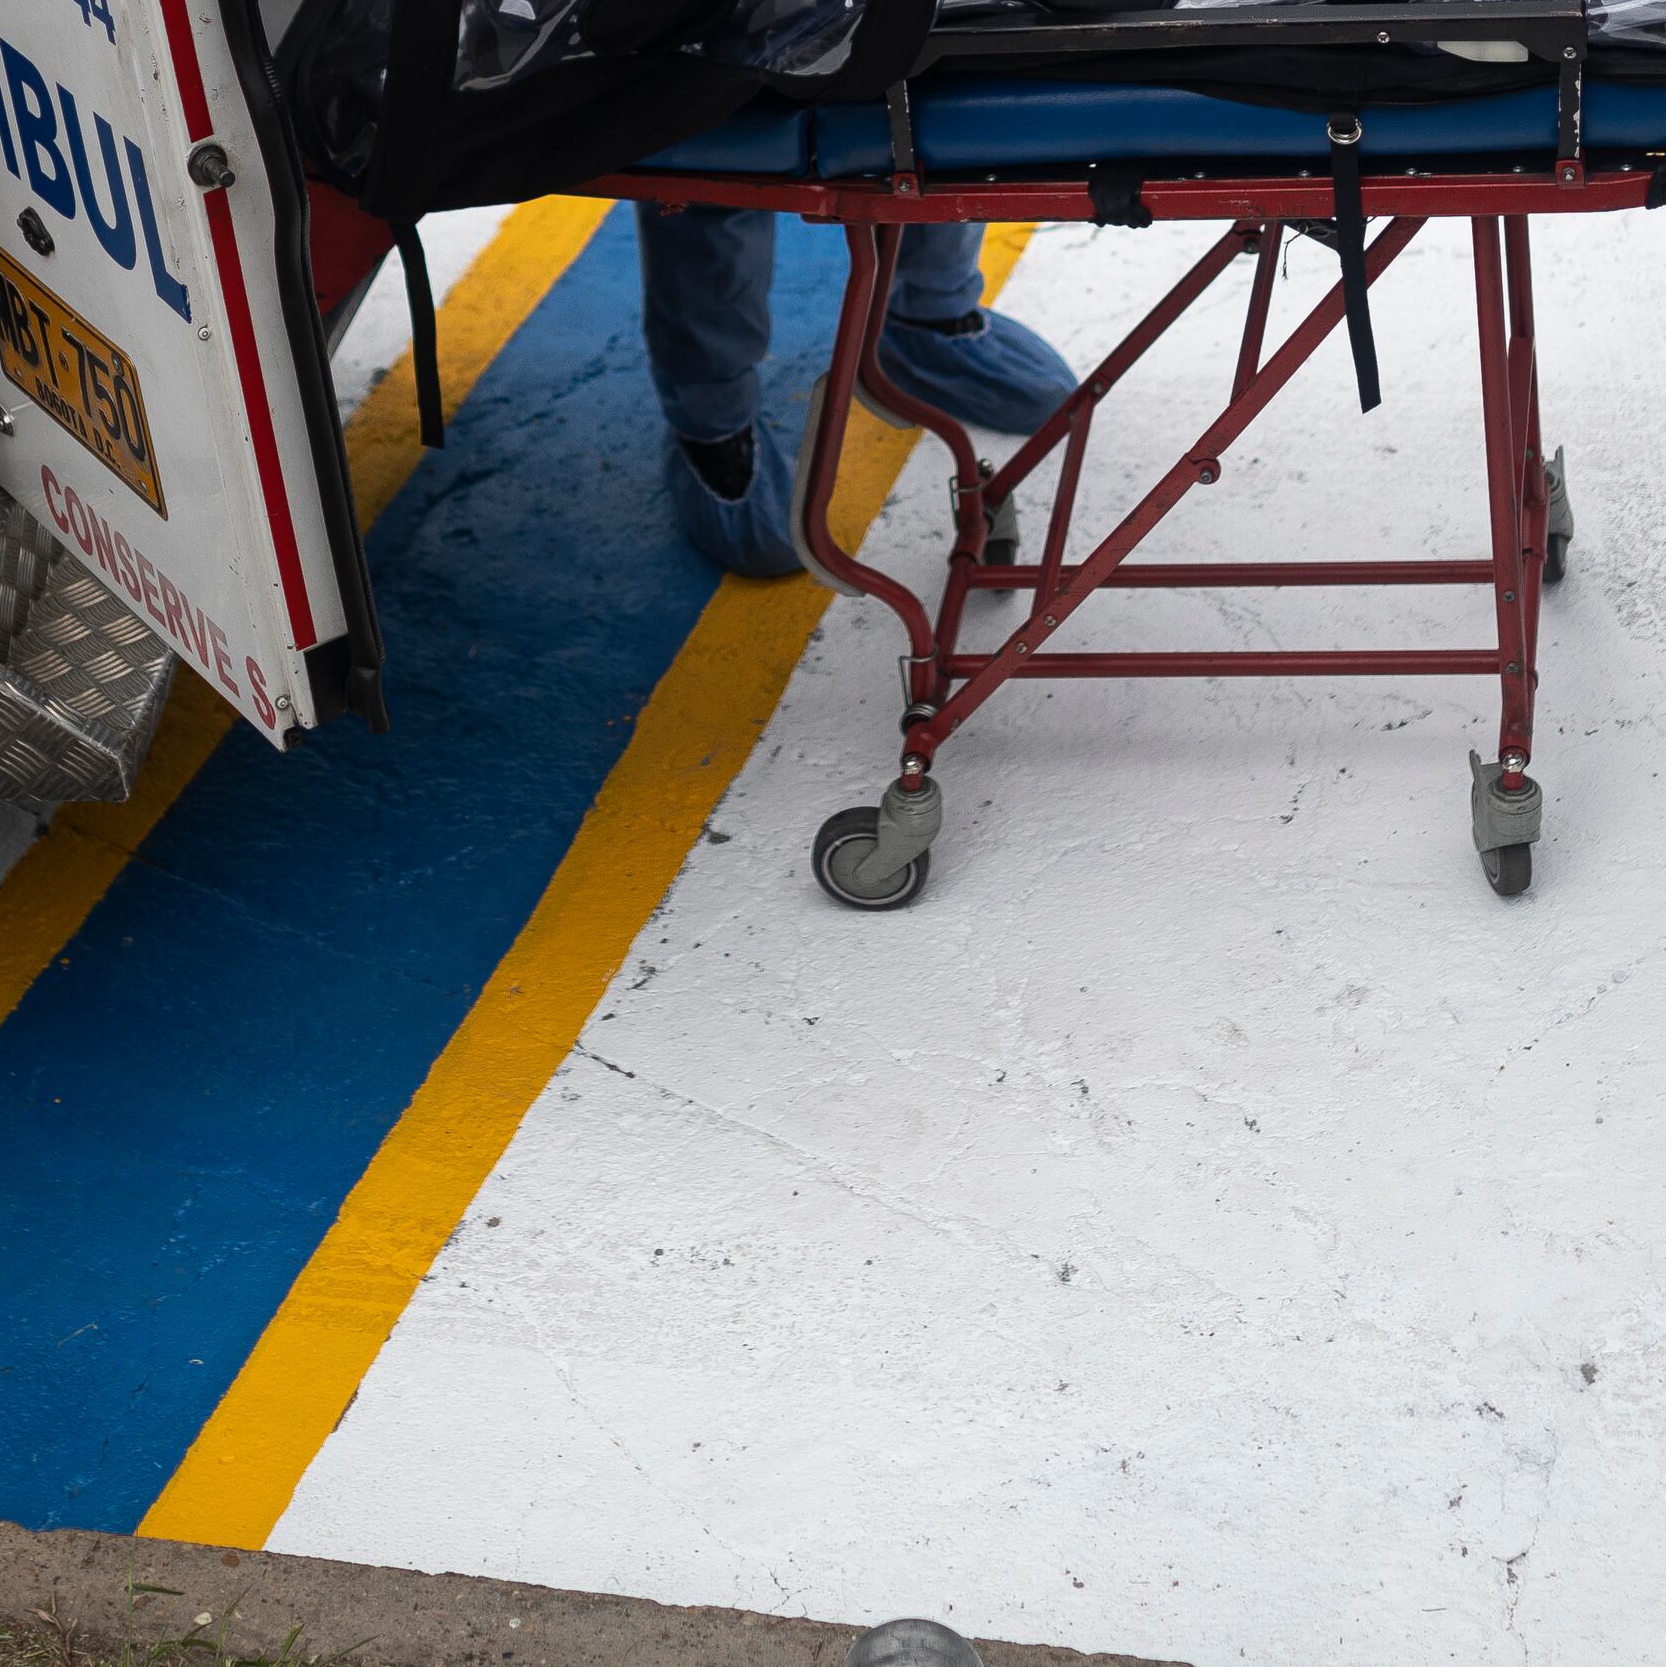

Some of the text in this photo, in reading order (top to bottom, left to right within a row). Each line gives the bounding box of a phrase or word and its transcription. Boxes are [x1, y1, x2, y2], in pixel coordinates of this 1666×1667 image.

[35, 376, 88, 440] BOGOTA
[62, 326, 148, 462] 750
[42, 465, 277, 730] CONSERVE S
